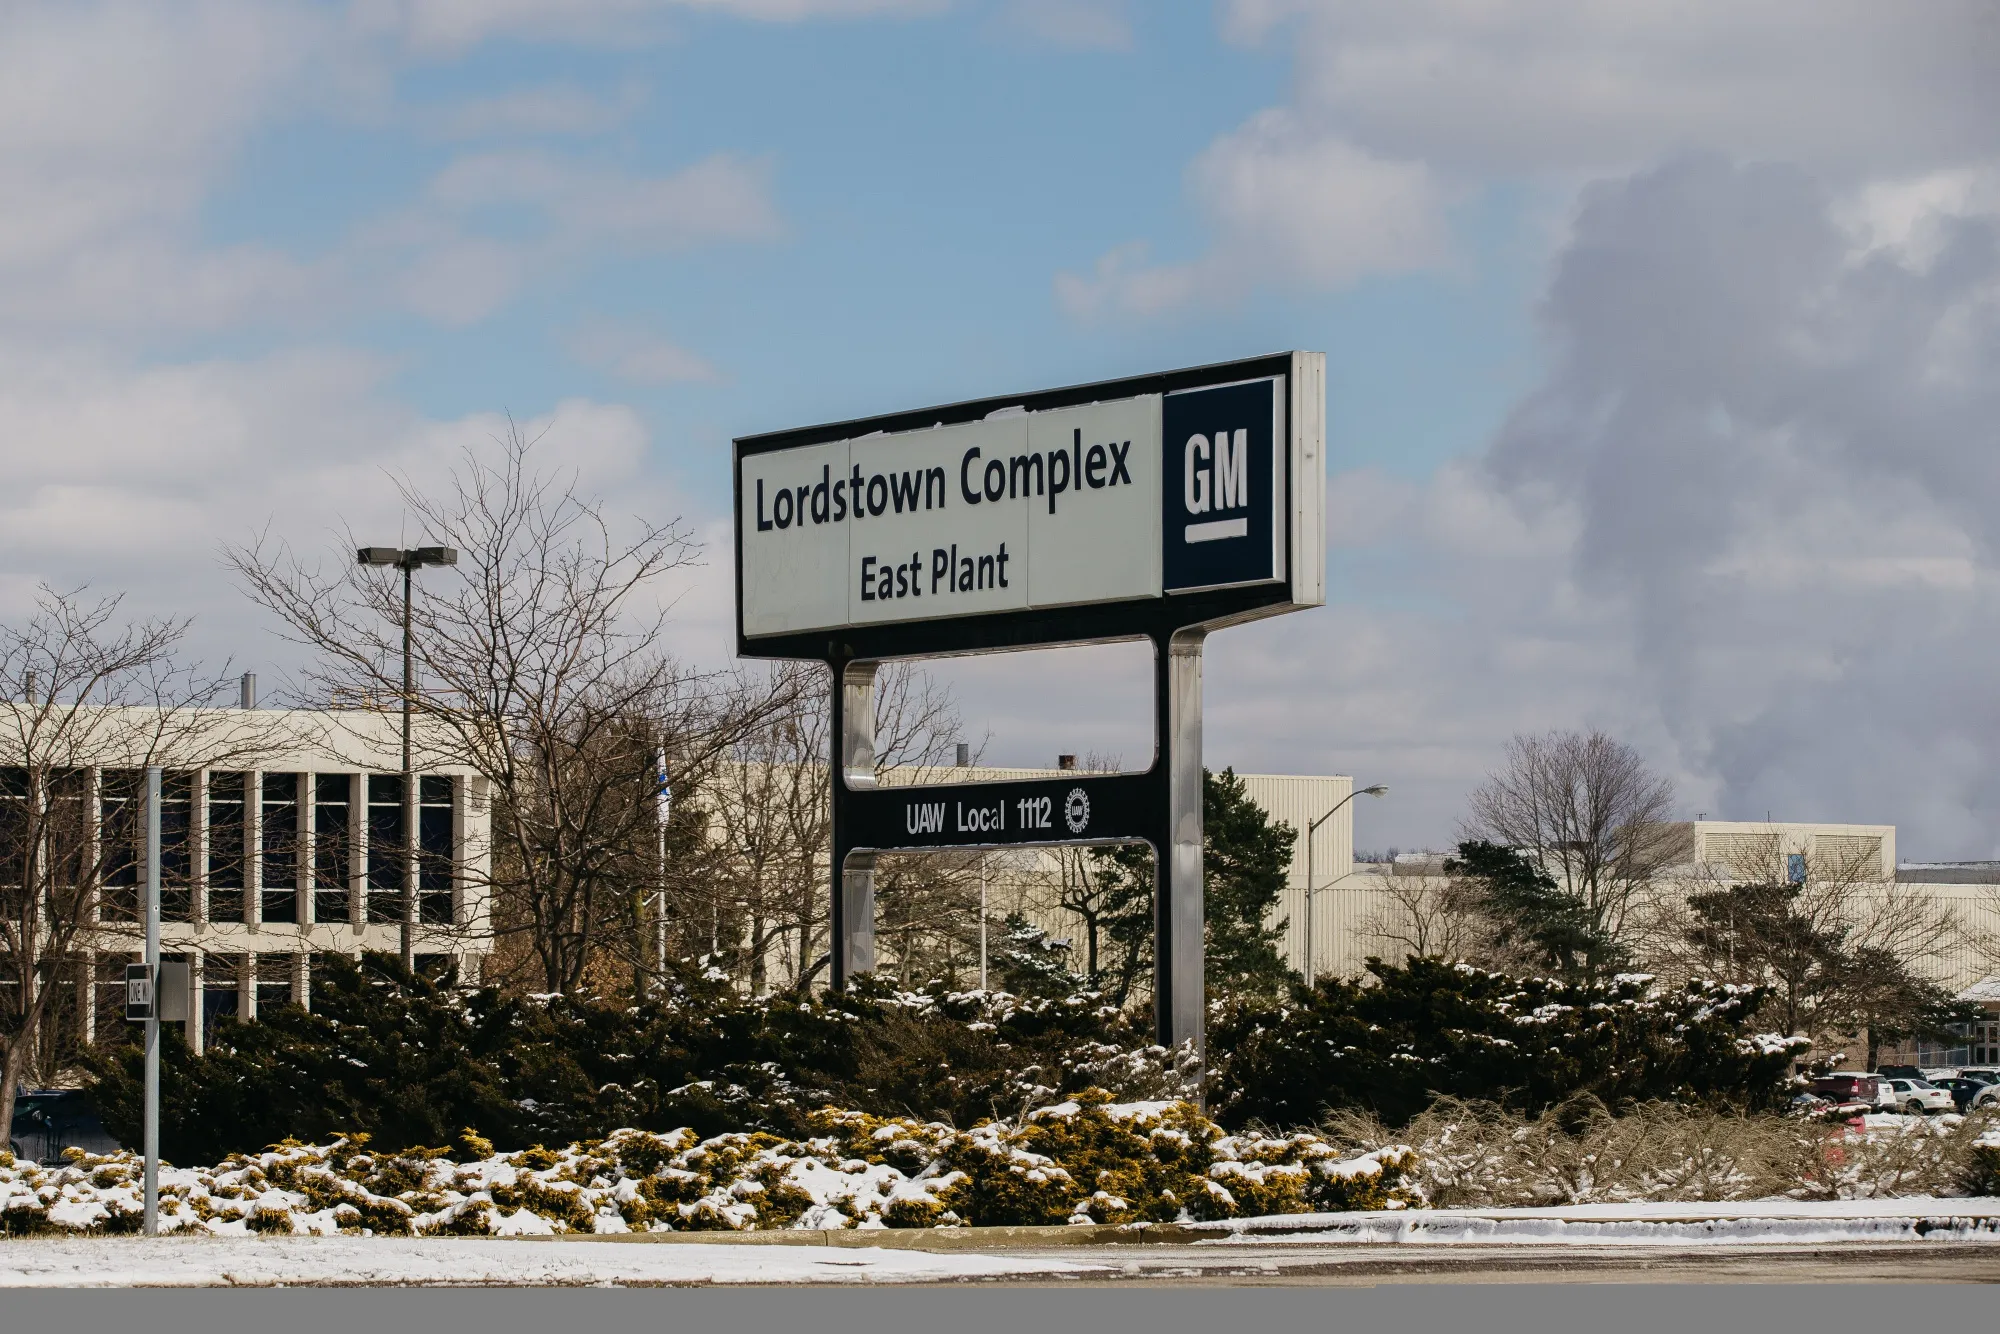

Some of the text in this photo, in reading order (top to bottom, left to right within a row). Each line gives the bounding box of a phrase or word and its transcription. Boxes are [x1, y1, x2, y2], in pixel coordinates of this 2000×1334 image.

[757, 428, 1132, 532] Lordstown Complex
[1185, 428, 1248, 515] GM
[861, 542, 1010, 601] East Plant
[906, 796, 1052, 835] UAW Local 1112
[1071, 805, 1083, 816] UAW
